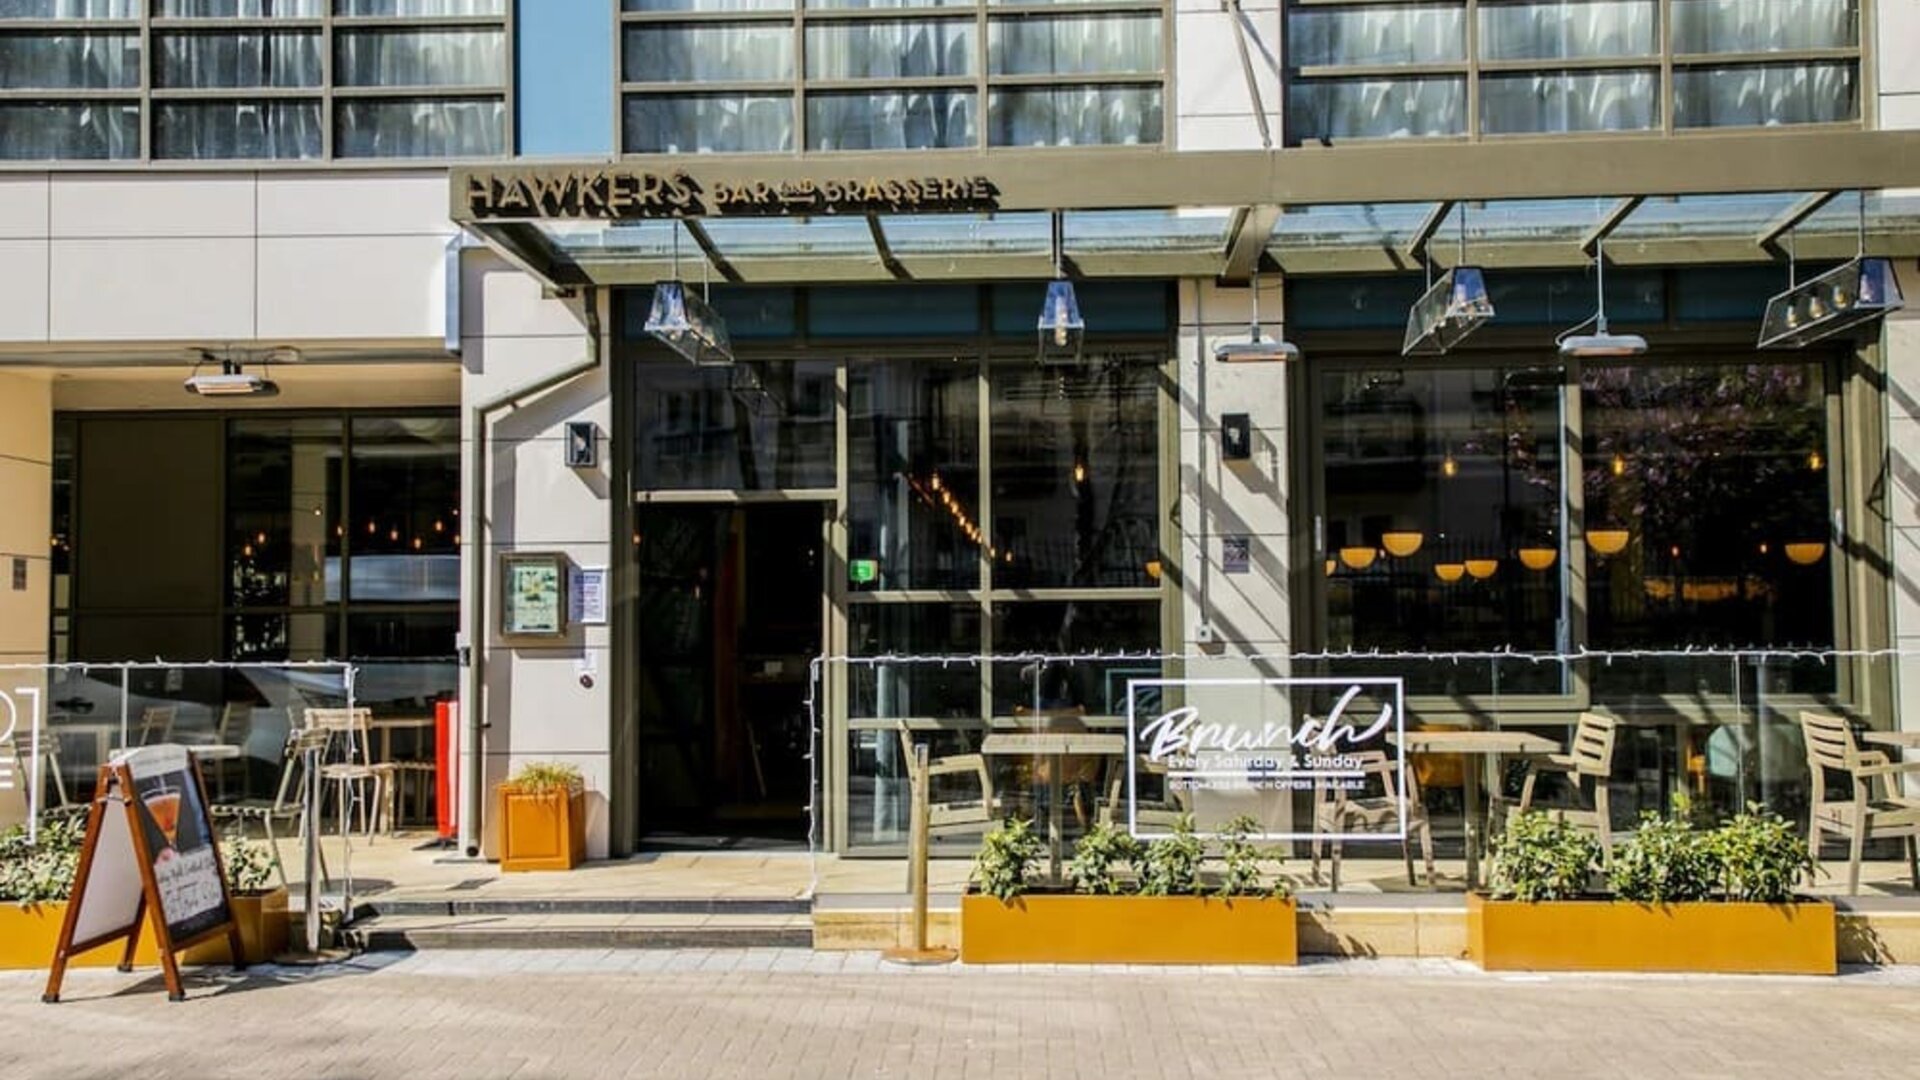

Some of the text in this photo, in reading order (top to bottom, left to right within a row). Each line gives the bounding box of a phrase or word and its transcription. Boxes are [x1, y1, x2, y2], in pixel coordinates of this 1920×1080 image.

[467, 172, 701, 210] HAWKERS
[714, 181, 770, 204] BAR
[823, 177, 992, 202] BRASSERIE
[1139, 684, 1393, 763] Brunch
[1168, 753, 1363, 770] Every Saturday & Sunday
